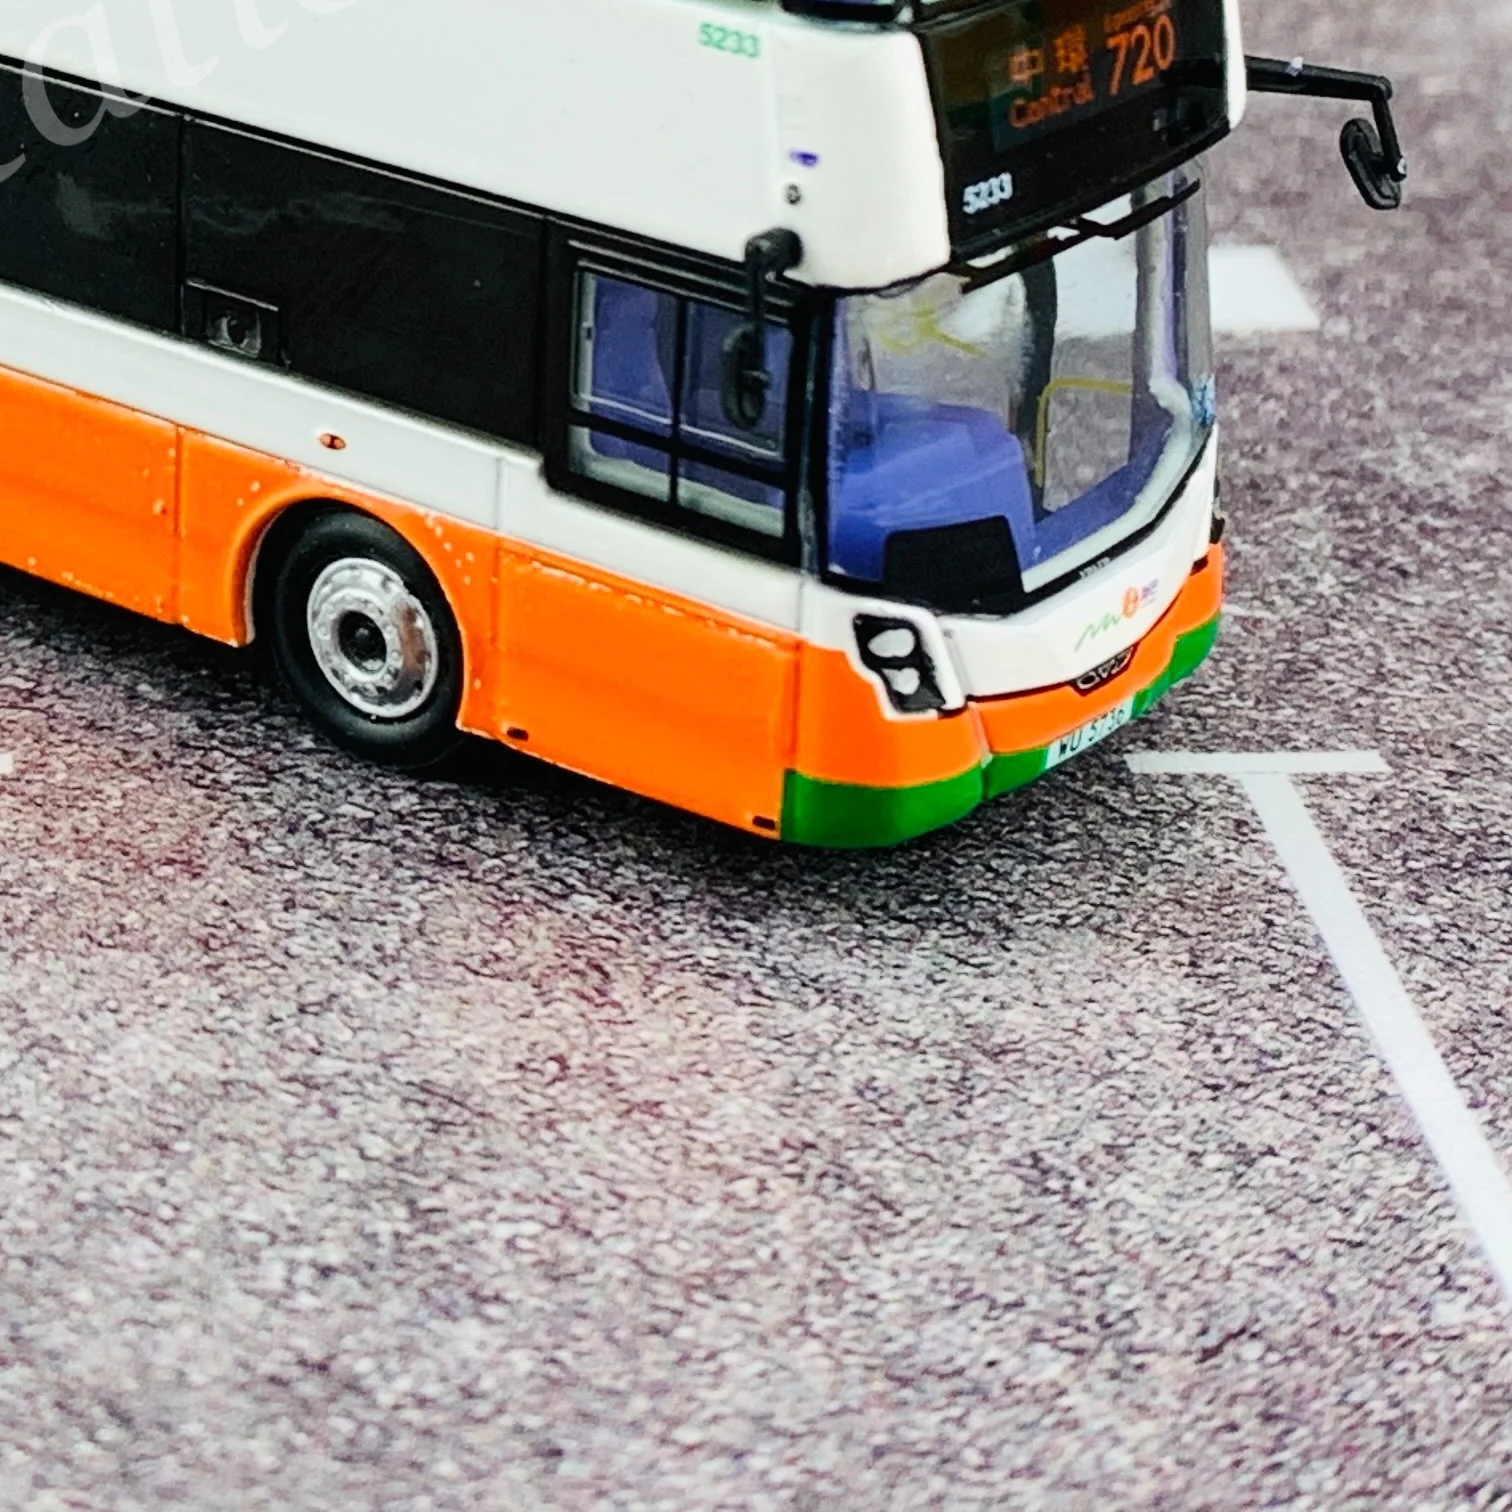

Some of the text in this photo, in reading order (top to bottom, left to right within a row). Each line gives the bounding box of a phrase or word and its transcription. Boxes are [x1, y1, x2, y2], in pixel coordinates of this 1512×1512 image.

[699, 22, 761, 59] 5233
[1105, 13, 1176, 97] 720
[1007, 76, 1095, 129] Central
[962, 171, 1014, 215] 5233
